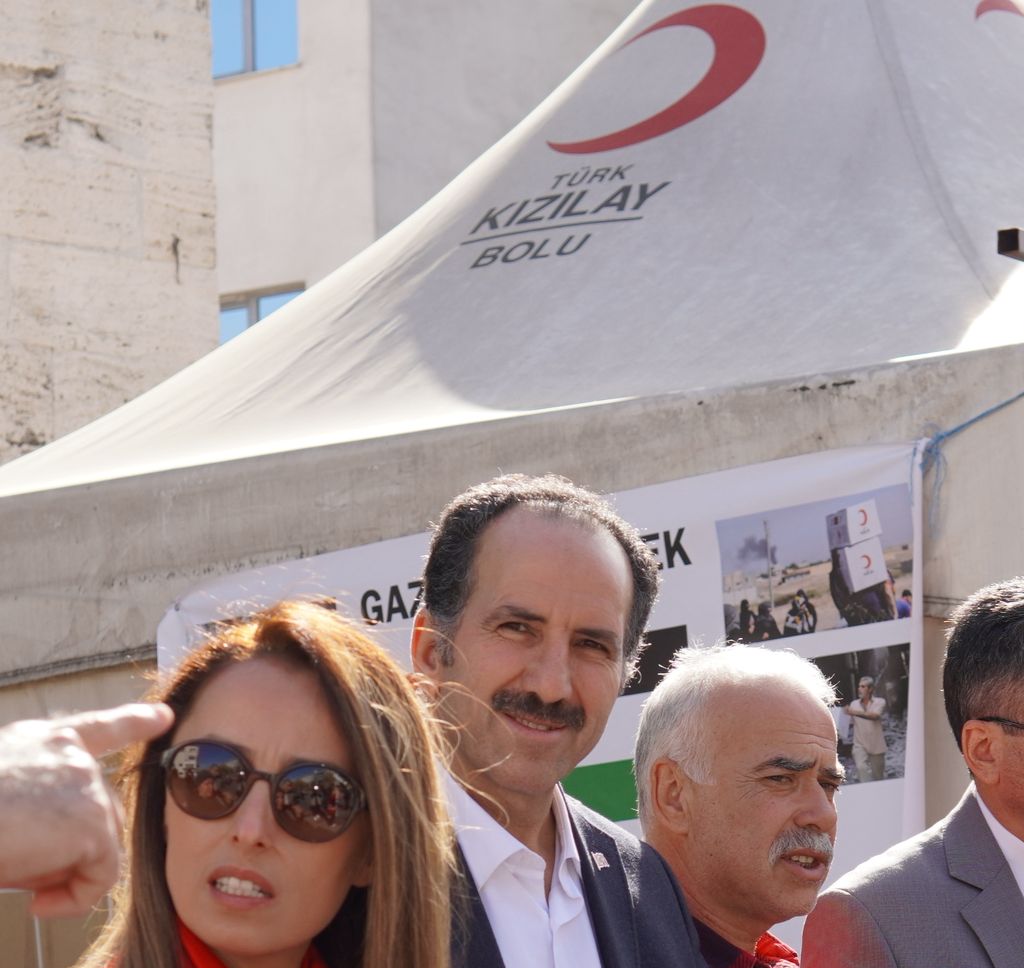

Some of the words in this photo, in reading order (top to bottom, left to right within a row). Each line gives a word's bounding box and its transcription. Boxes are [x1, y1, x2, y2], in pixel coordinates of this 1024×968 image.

[552, 164, 634, 189] TÜRK
[469, 181, 672, 235] KIZILAY
[470, 234, 592, 269] BOLU
[361, 580, 425, 625] GAZ
